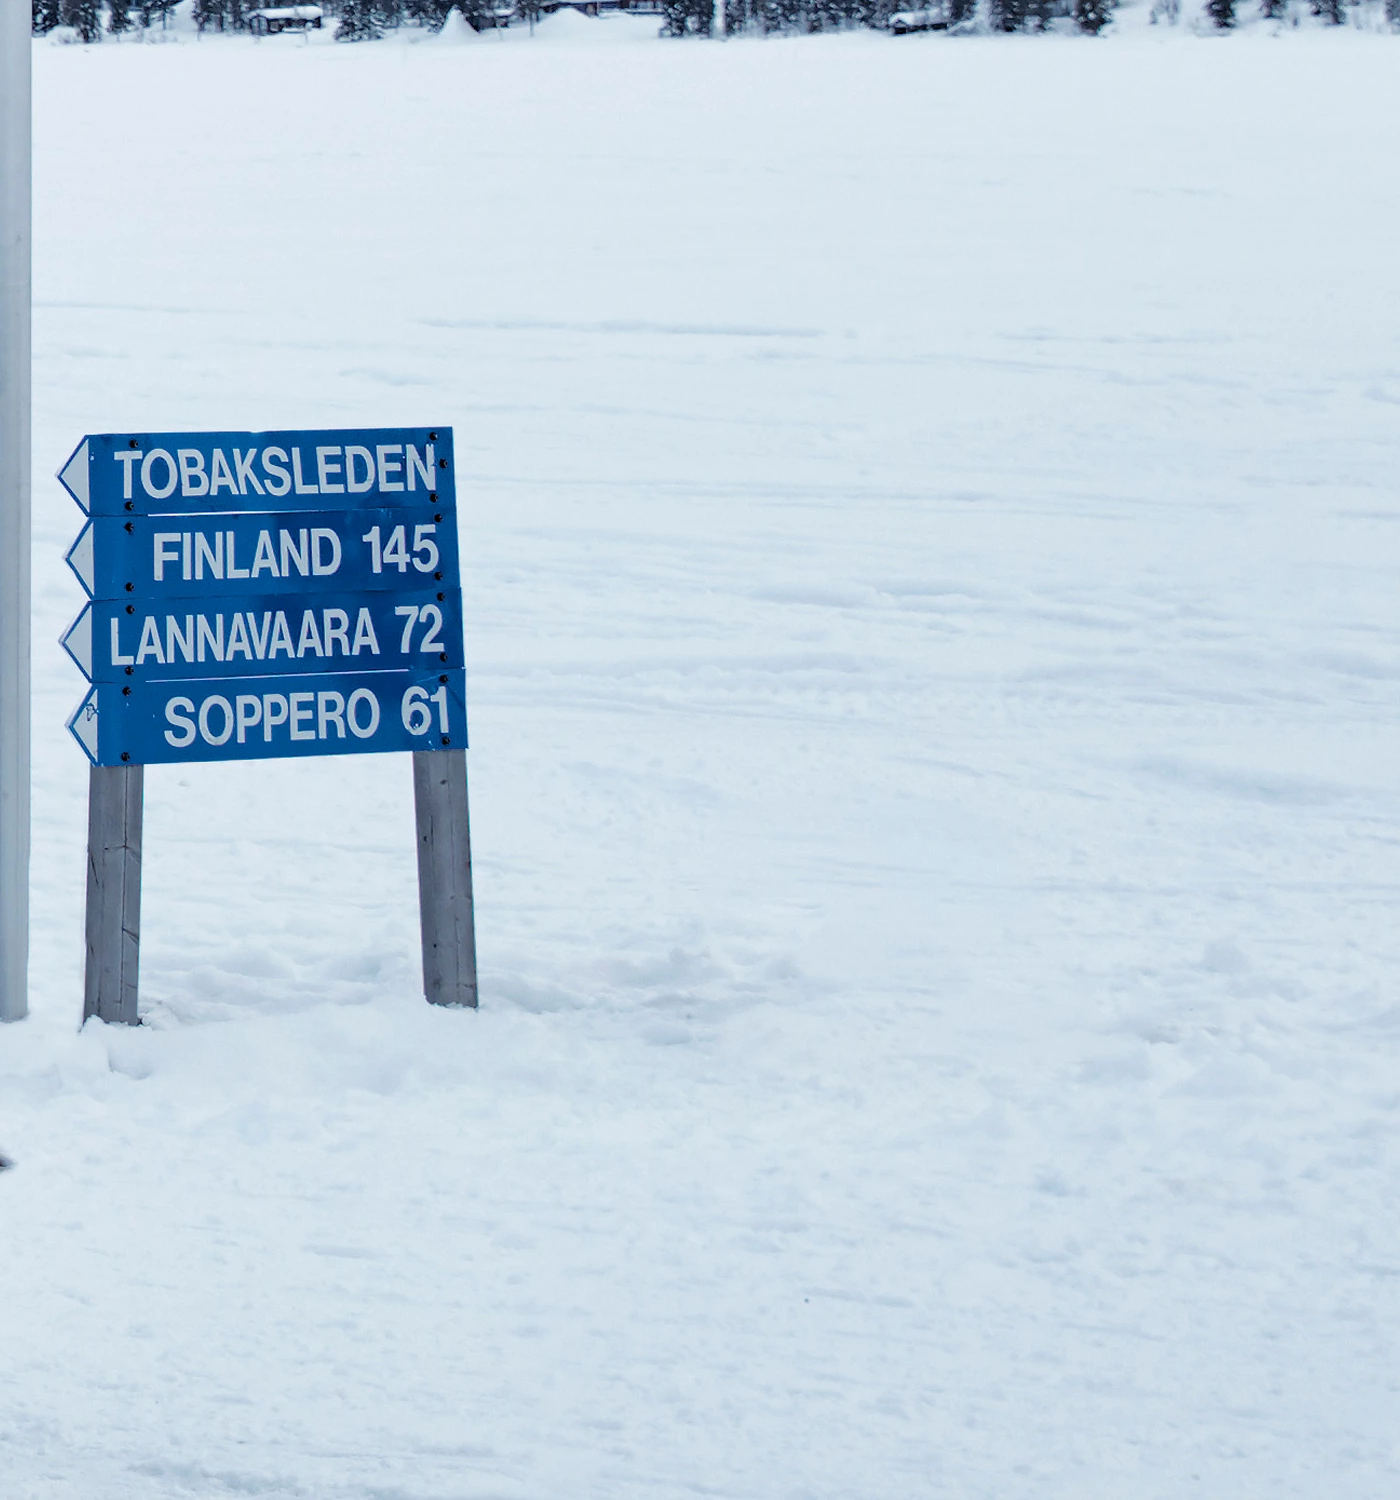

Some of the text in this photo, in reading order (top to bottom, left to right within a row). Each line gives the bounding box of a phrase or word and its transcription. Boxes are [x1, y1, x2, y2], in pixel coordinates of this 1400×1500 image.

[114, 443, 437, 499] TOBAKSLEDEN
[153, 524, 439, 581] FINLAND 145
[110, 604, 445, 666] LANNAVAARA 72
[164, 686, 450, 747] SOPPERO 61
